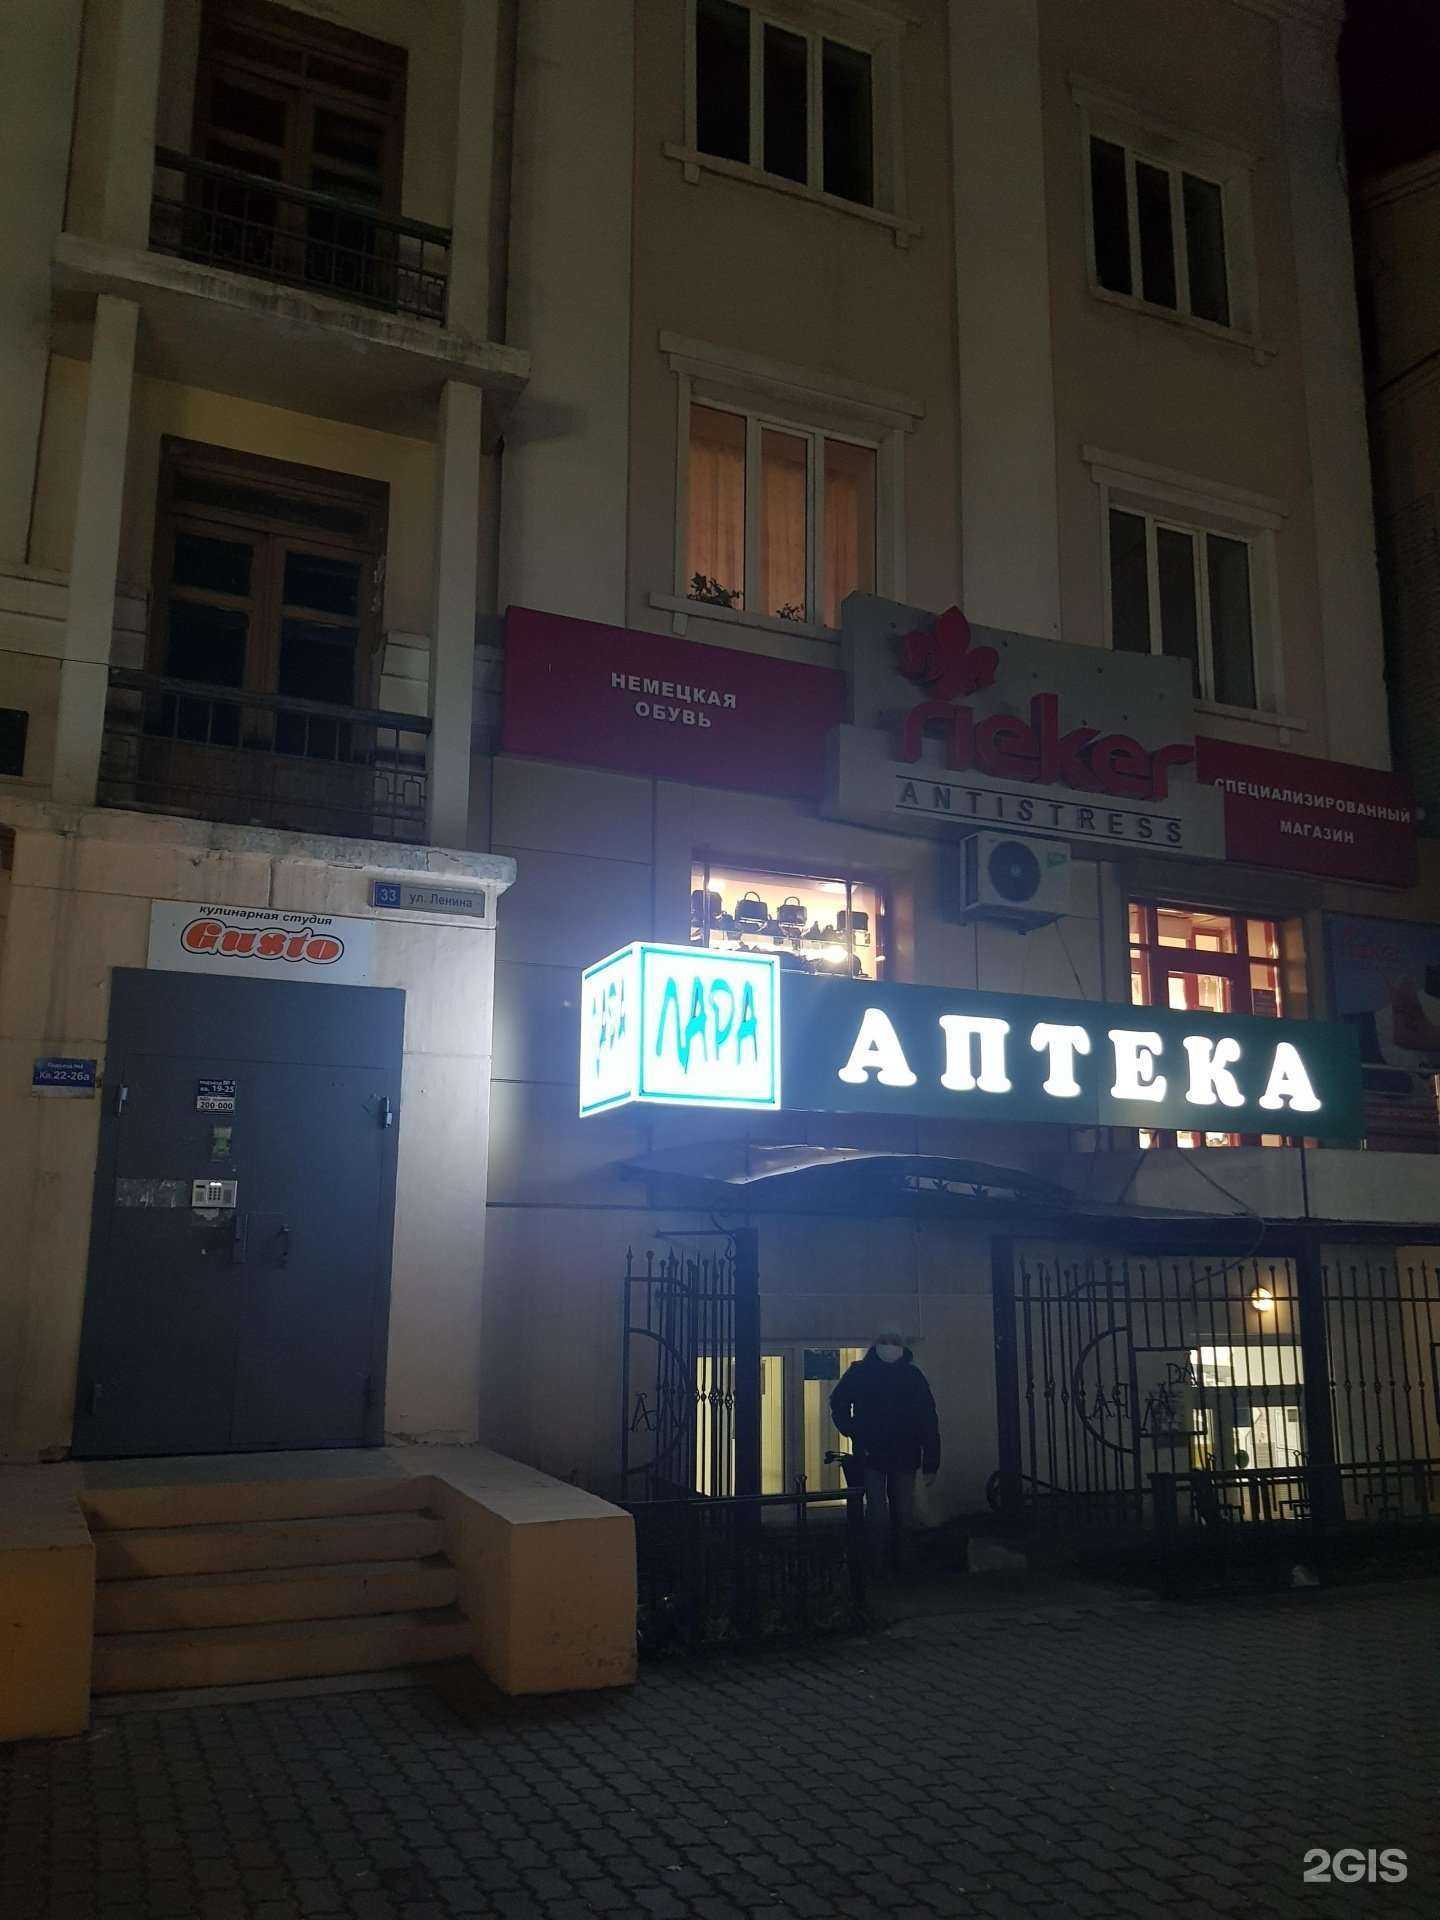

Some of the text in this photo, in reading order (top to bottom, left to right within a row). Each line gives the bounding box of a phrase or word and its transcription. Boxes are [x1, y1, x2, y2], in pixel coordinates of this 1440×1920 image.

[610, 672, 737, 709] НЕМЕЦКАЯ
[635, 701, 712, 728] ОБУВЬ
[899, 693, 1194, 801] rieker
[899, 781, 1183, 843] ANTISTRESS
[1213, 778, 1411, 824] СПЕЦИАЛИЗИРОВАННЫЙ
[1279, 820, 1356, 845] МАГАЗИН
[199, 905, 333, 926] кулинарная студия
[381, 889, 396, 902] 33
[430, 894, 473, 908] Ленина
[183, 920, 342, 962] Gusto
[656, 976, 759, 1075] ЛАРА
[838, 1007, 1323, 1113] АПТЕКА
